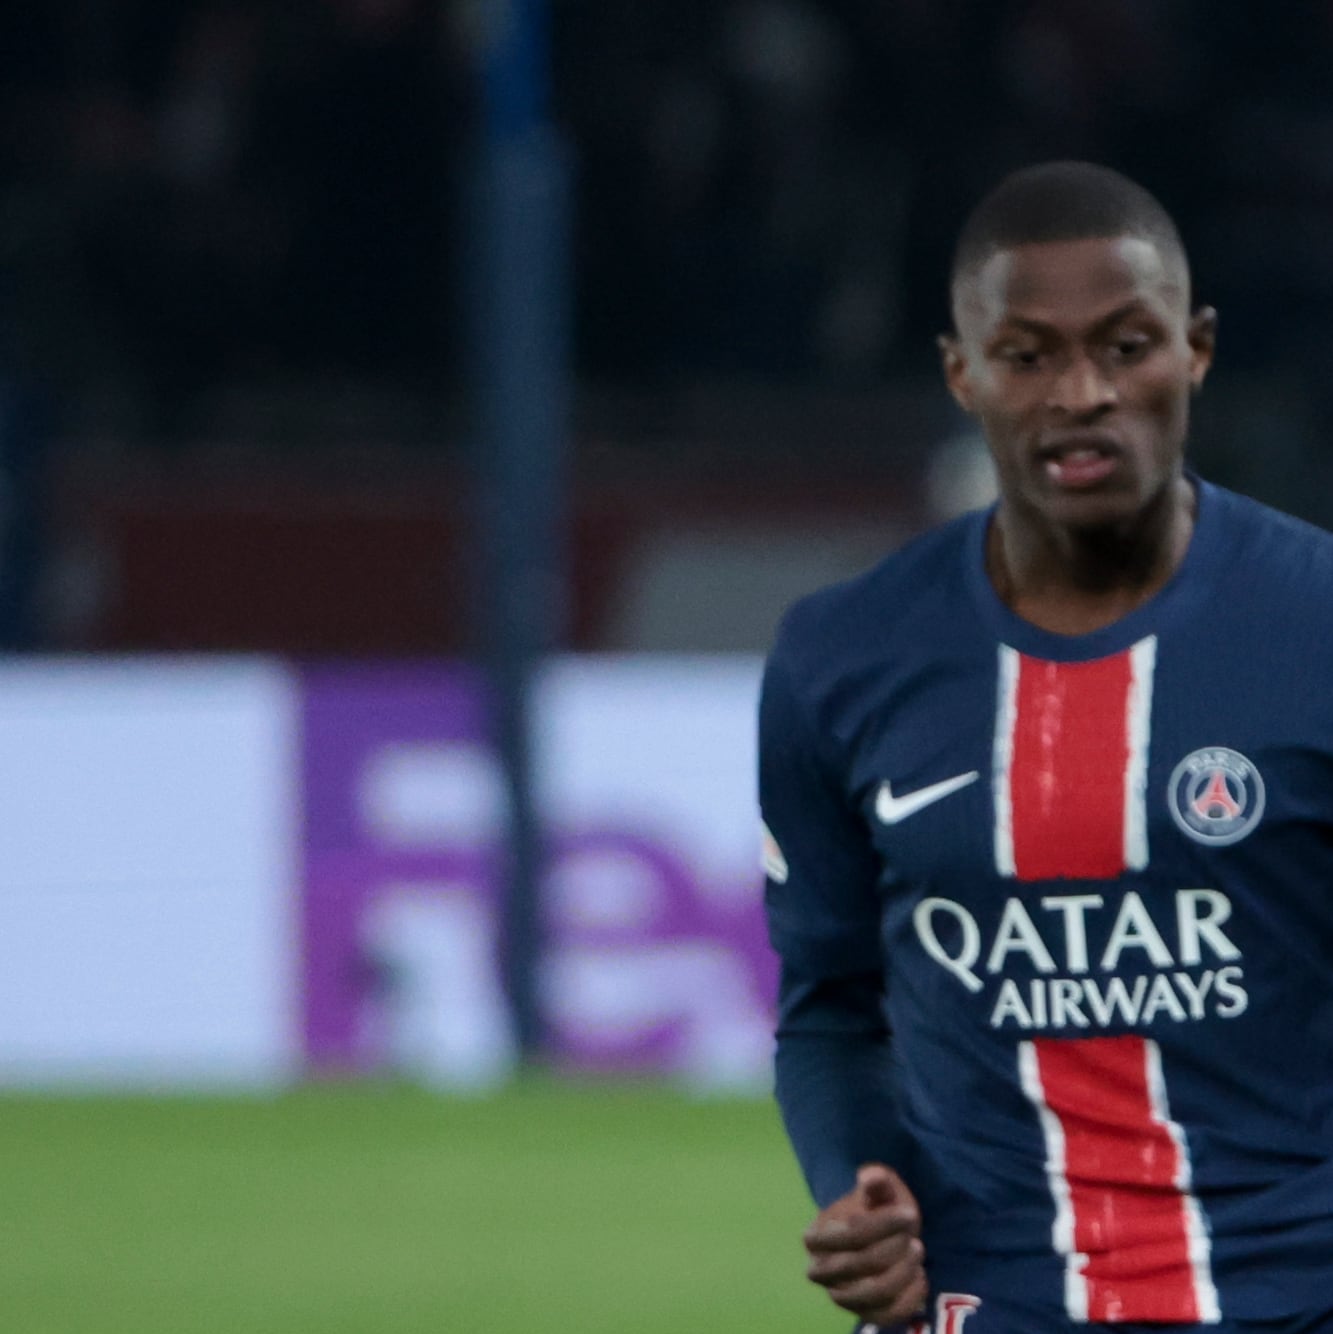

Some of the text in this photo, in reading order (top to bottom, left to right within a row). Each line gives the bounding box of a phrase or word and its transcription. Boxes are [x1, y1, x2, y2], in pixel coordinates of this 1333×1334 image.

[293, 660, 780, 1085] Fe
[912, 889, 1242, 992] QATAR
[990, 966, 1248, 1028] AIRWAYS
